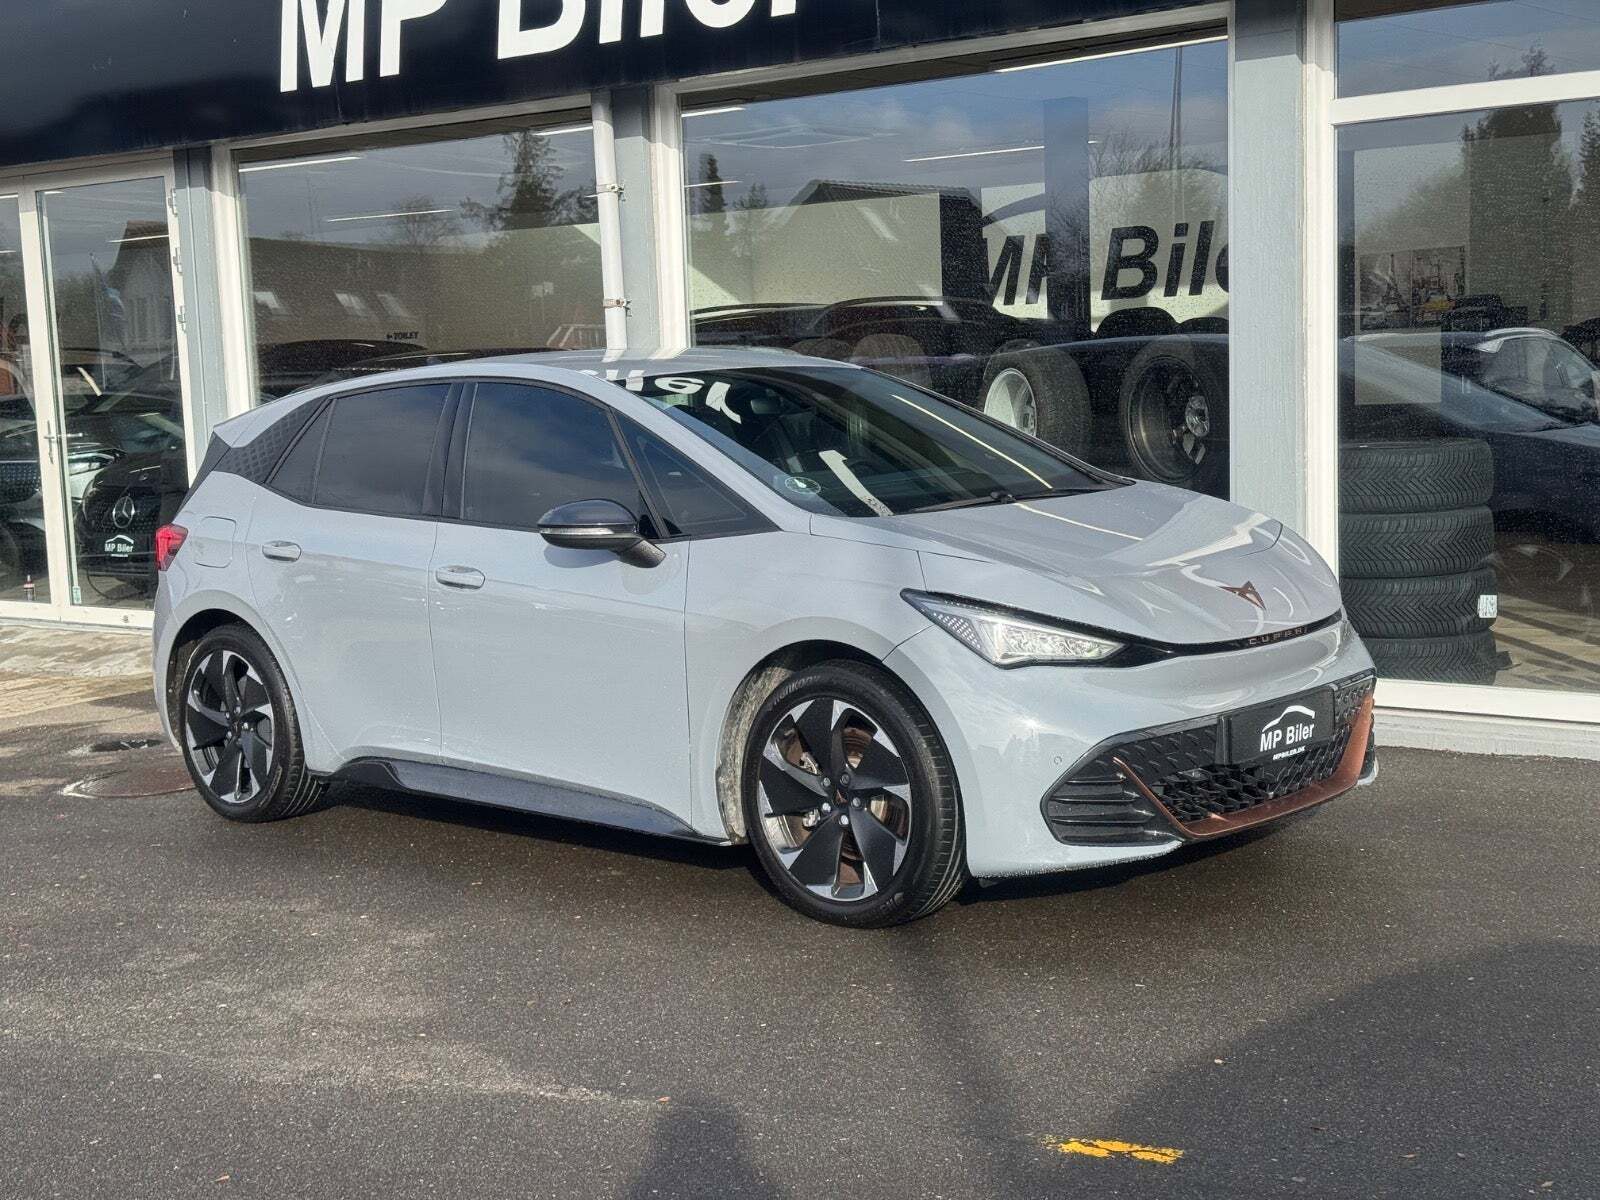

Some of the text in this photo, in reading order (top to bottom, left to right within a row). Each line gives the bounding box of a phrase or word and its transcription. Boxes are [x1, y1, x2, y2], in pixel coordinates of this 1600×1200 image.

[104, 543, 133, 552] MP Biler
[1260, 723, 1314, 752] MP Biler
